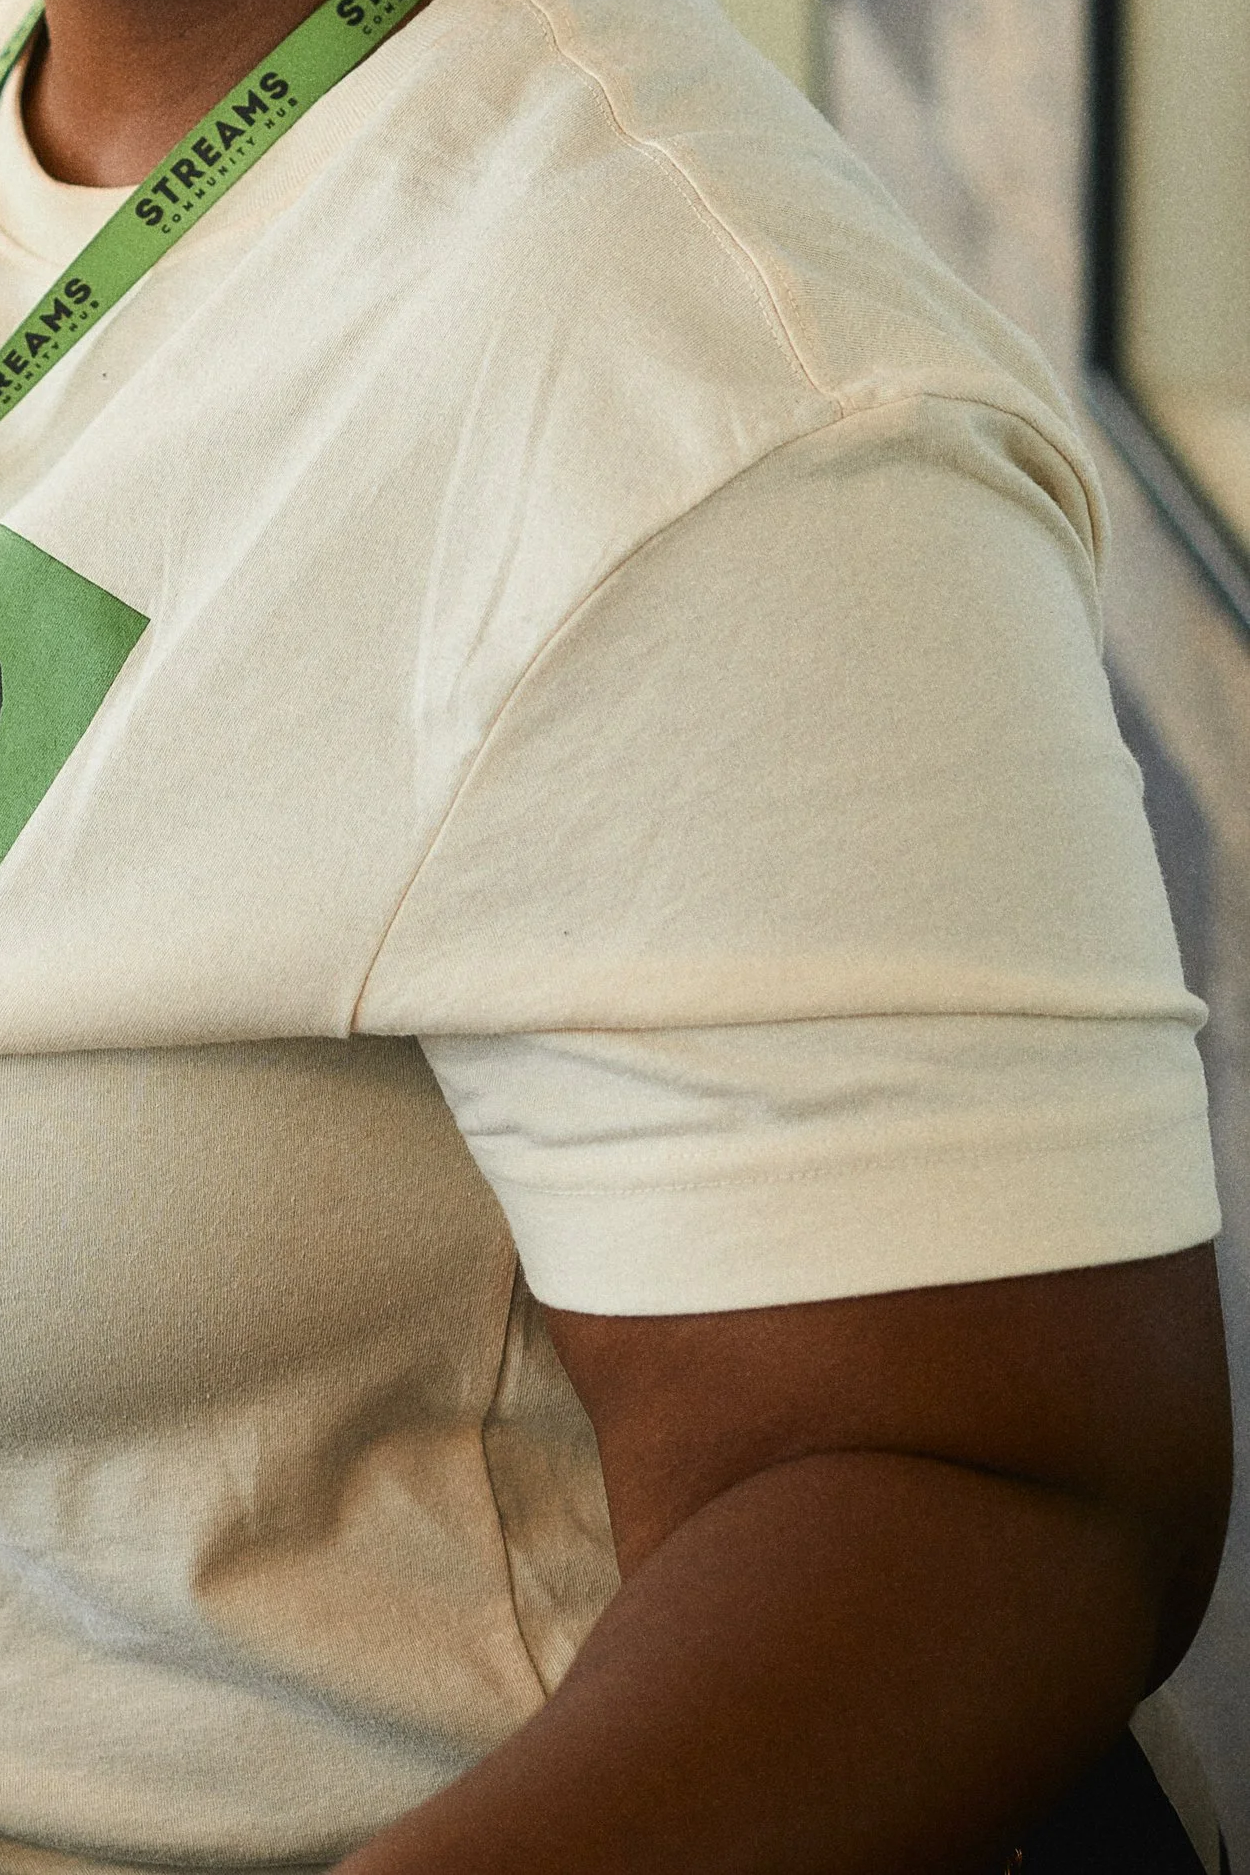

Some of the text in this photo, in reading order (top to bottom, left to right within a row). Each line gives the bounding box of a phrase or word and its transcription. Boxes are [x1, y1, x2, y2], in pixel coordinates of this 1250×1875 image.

[135, 72, 289, 226] STREAMS
[161, 97, 298, 234] COMMUNITY HUB
[69, 300, 99, 332] HUB
